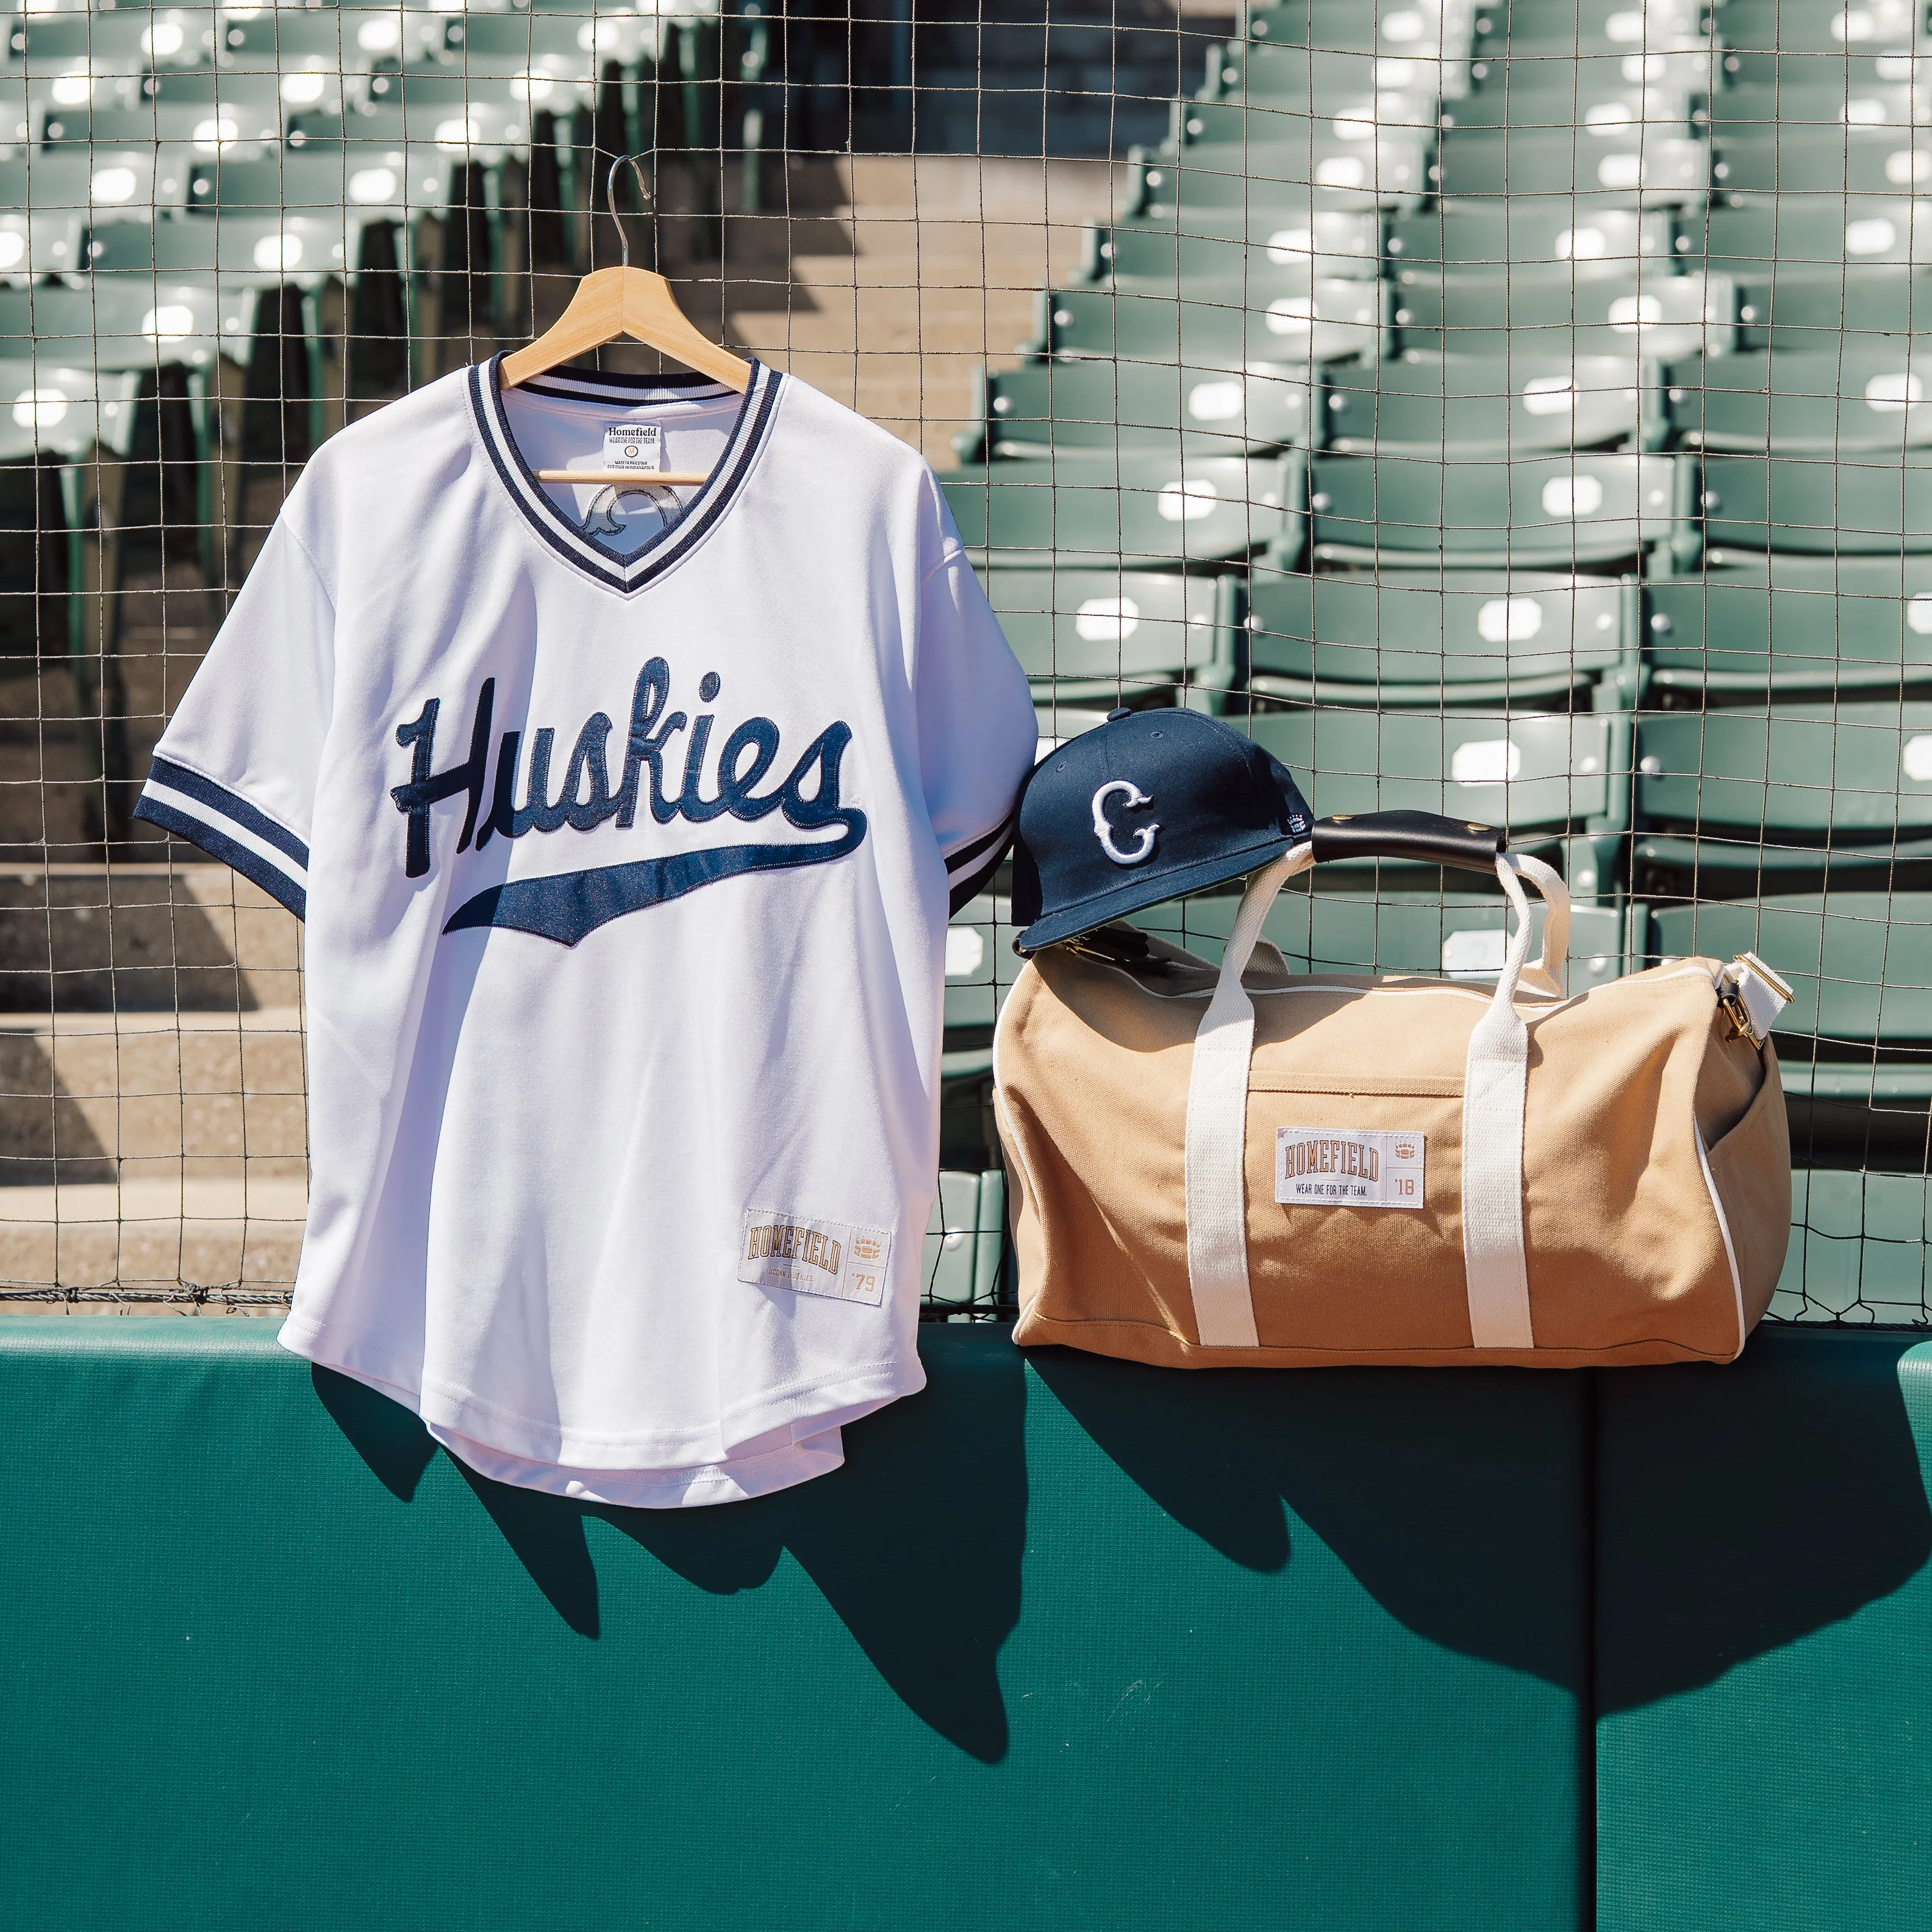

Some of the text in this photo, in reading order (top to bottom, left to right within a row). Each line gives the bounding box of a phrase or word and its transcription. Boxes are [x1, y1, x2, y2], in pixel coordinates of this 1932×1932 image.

[608, 427, 657, 436] Homefield
[390, 656, 868, 879] Huskies
[1092, 779, 1160, 865] C
[1284, 1140, 1379, 1182] HOMEFIELD
[1296, 1183, 1367, 1197] WEAR ONE FOR THE TEAM.
[748, 1225, 842, 1275] HOMEFIELD
[768, 1267, 814, 1282] UCONN HUSKIES
